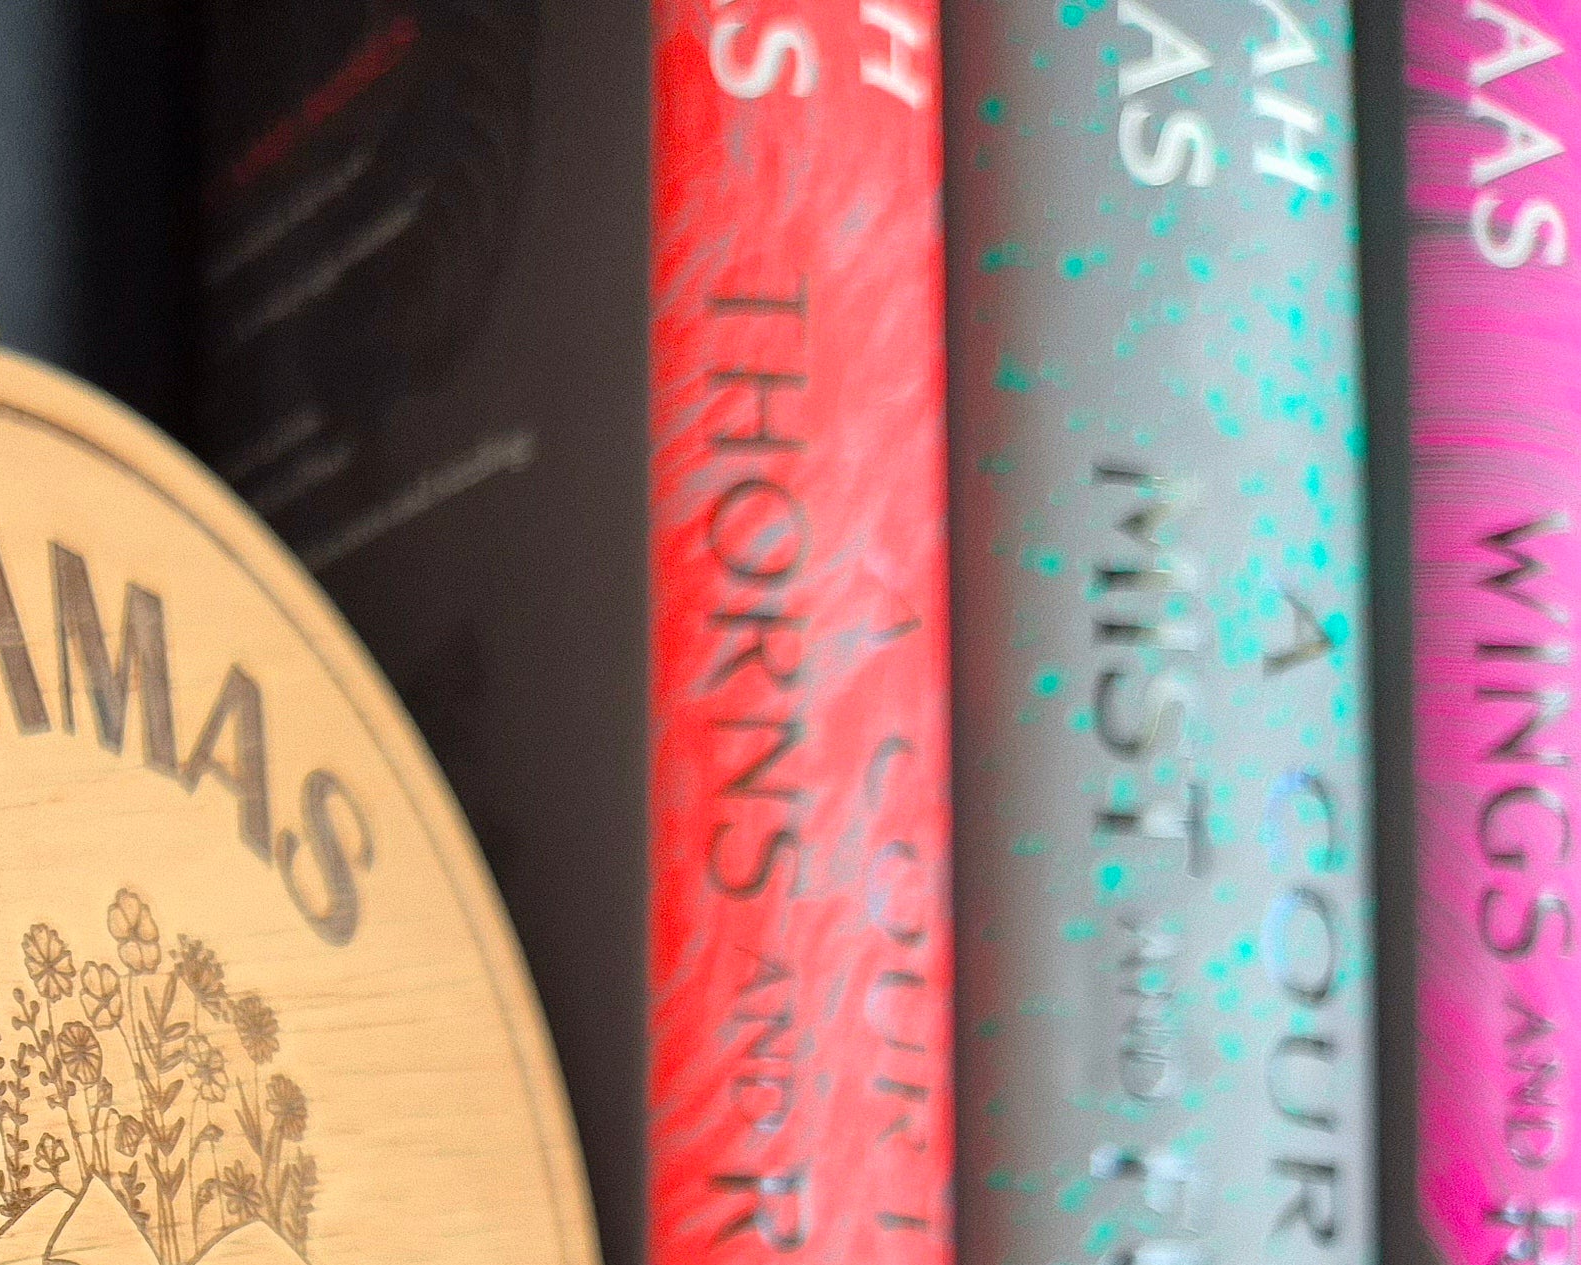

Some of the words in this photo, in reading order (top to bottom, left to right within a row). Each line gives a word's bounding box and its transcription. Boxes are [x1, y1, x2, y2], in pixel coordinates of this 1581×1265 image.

[707, 0, 819, 100] S
[1466, 0, 1569, 269] AAS
[705, 272, 810, 900] THORNS
[1092, 460, 1215, 879] MIST
[1262, 584, 1339, 677] A
[1473, 508, 1575, 963] WINGS
[729, 945, 797, 1135] AND
[1502, 988, 1564, 1170] AND
